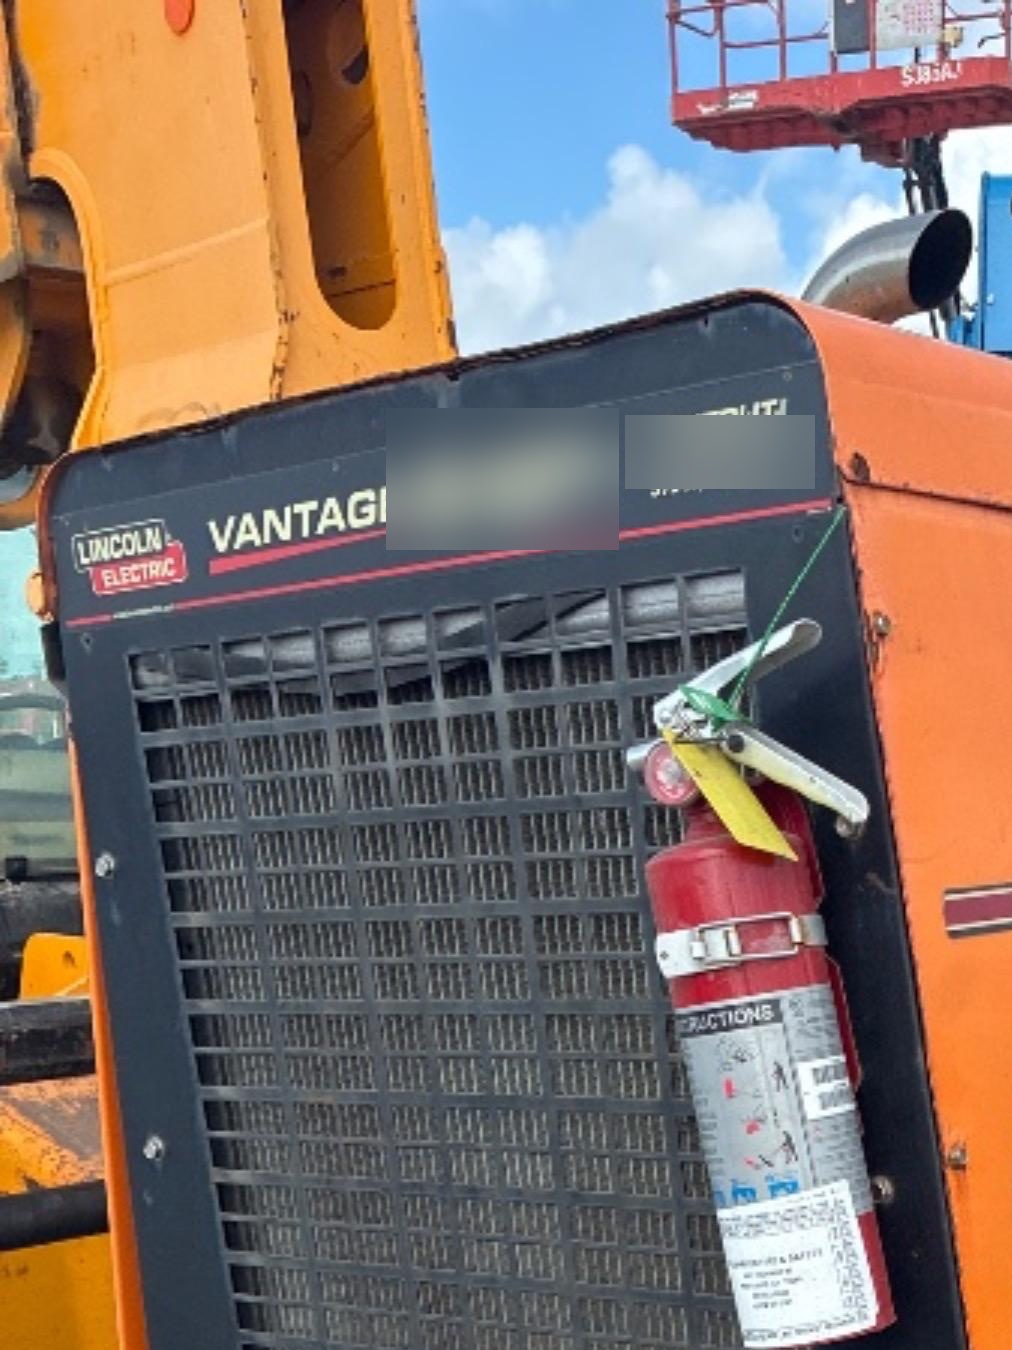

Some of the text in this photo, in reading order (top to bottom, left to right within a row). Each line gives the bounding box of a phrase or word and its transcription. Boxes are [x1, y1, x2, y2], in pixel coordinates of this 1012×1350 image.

[208, 484, 387, 553] VANTAG
[77, 526, 163, 565] LINCOLN
[101, 557, 176, 588] ELECTRIC
